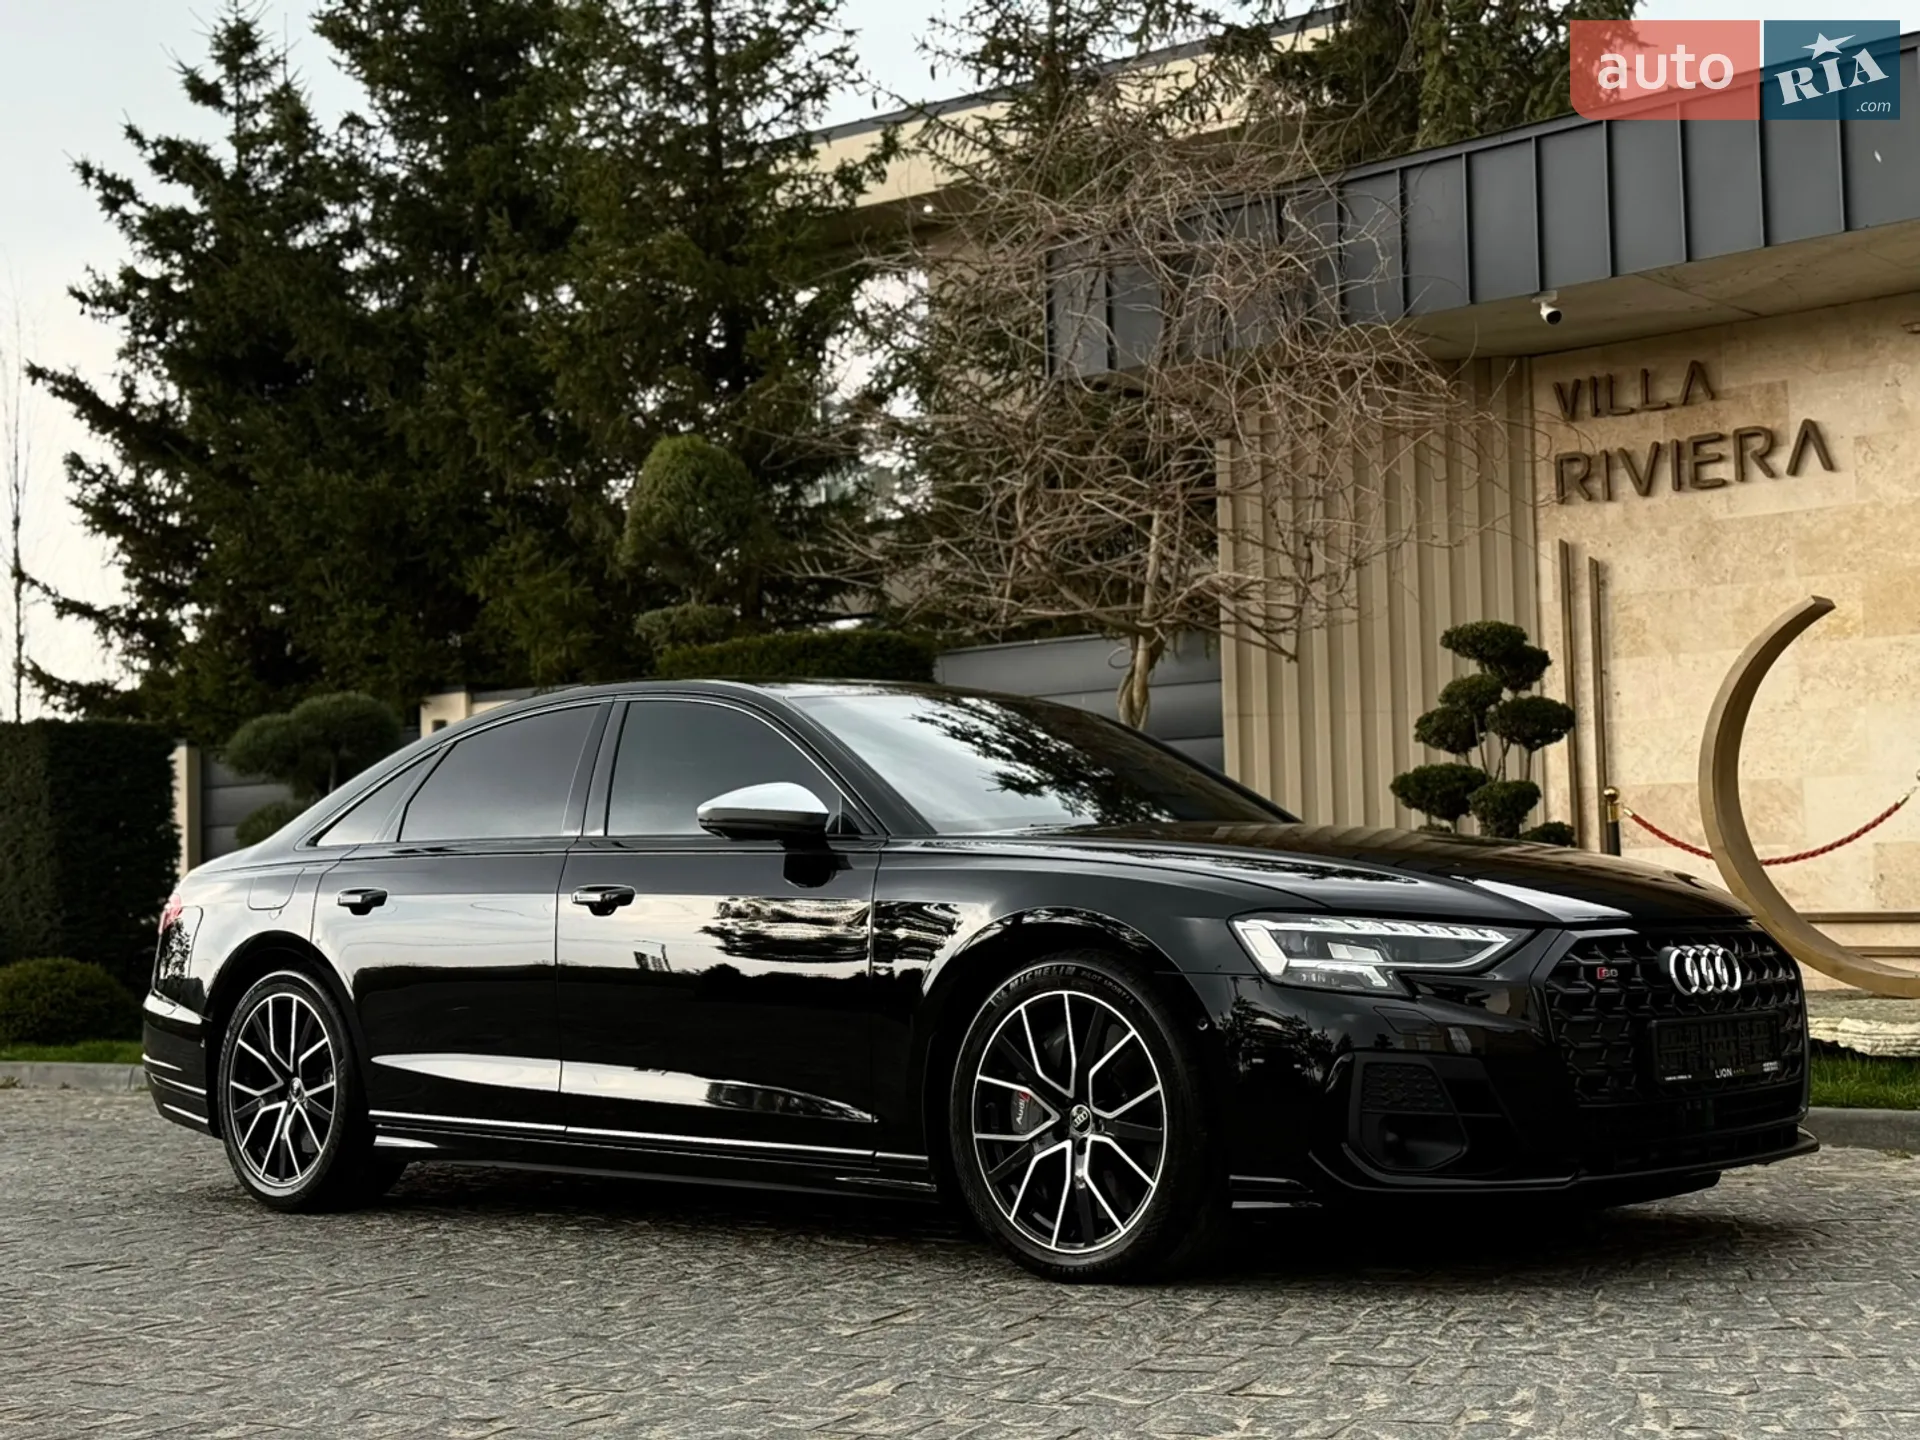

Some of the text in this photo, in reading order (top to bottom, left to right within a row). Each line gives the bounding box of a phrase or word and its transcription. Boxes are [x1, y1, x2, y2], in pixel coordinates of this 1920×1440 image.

[1553, 360, 1716, 422] VILLA
[1554, 418, 1834, 505] RIVIERA
[1009, 965, 1077, 991] MICHELIN
[1015, 1099, 1025, 1126] Audi
